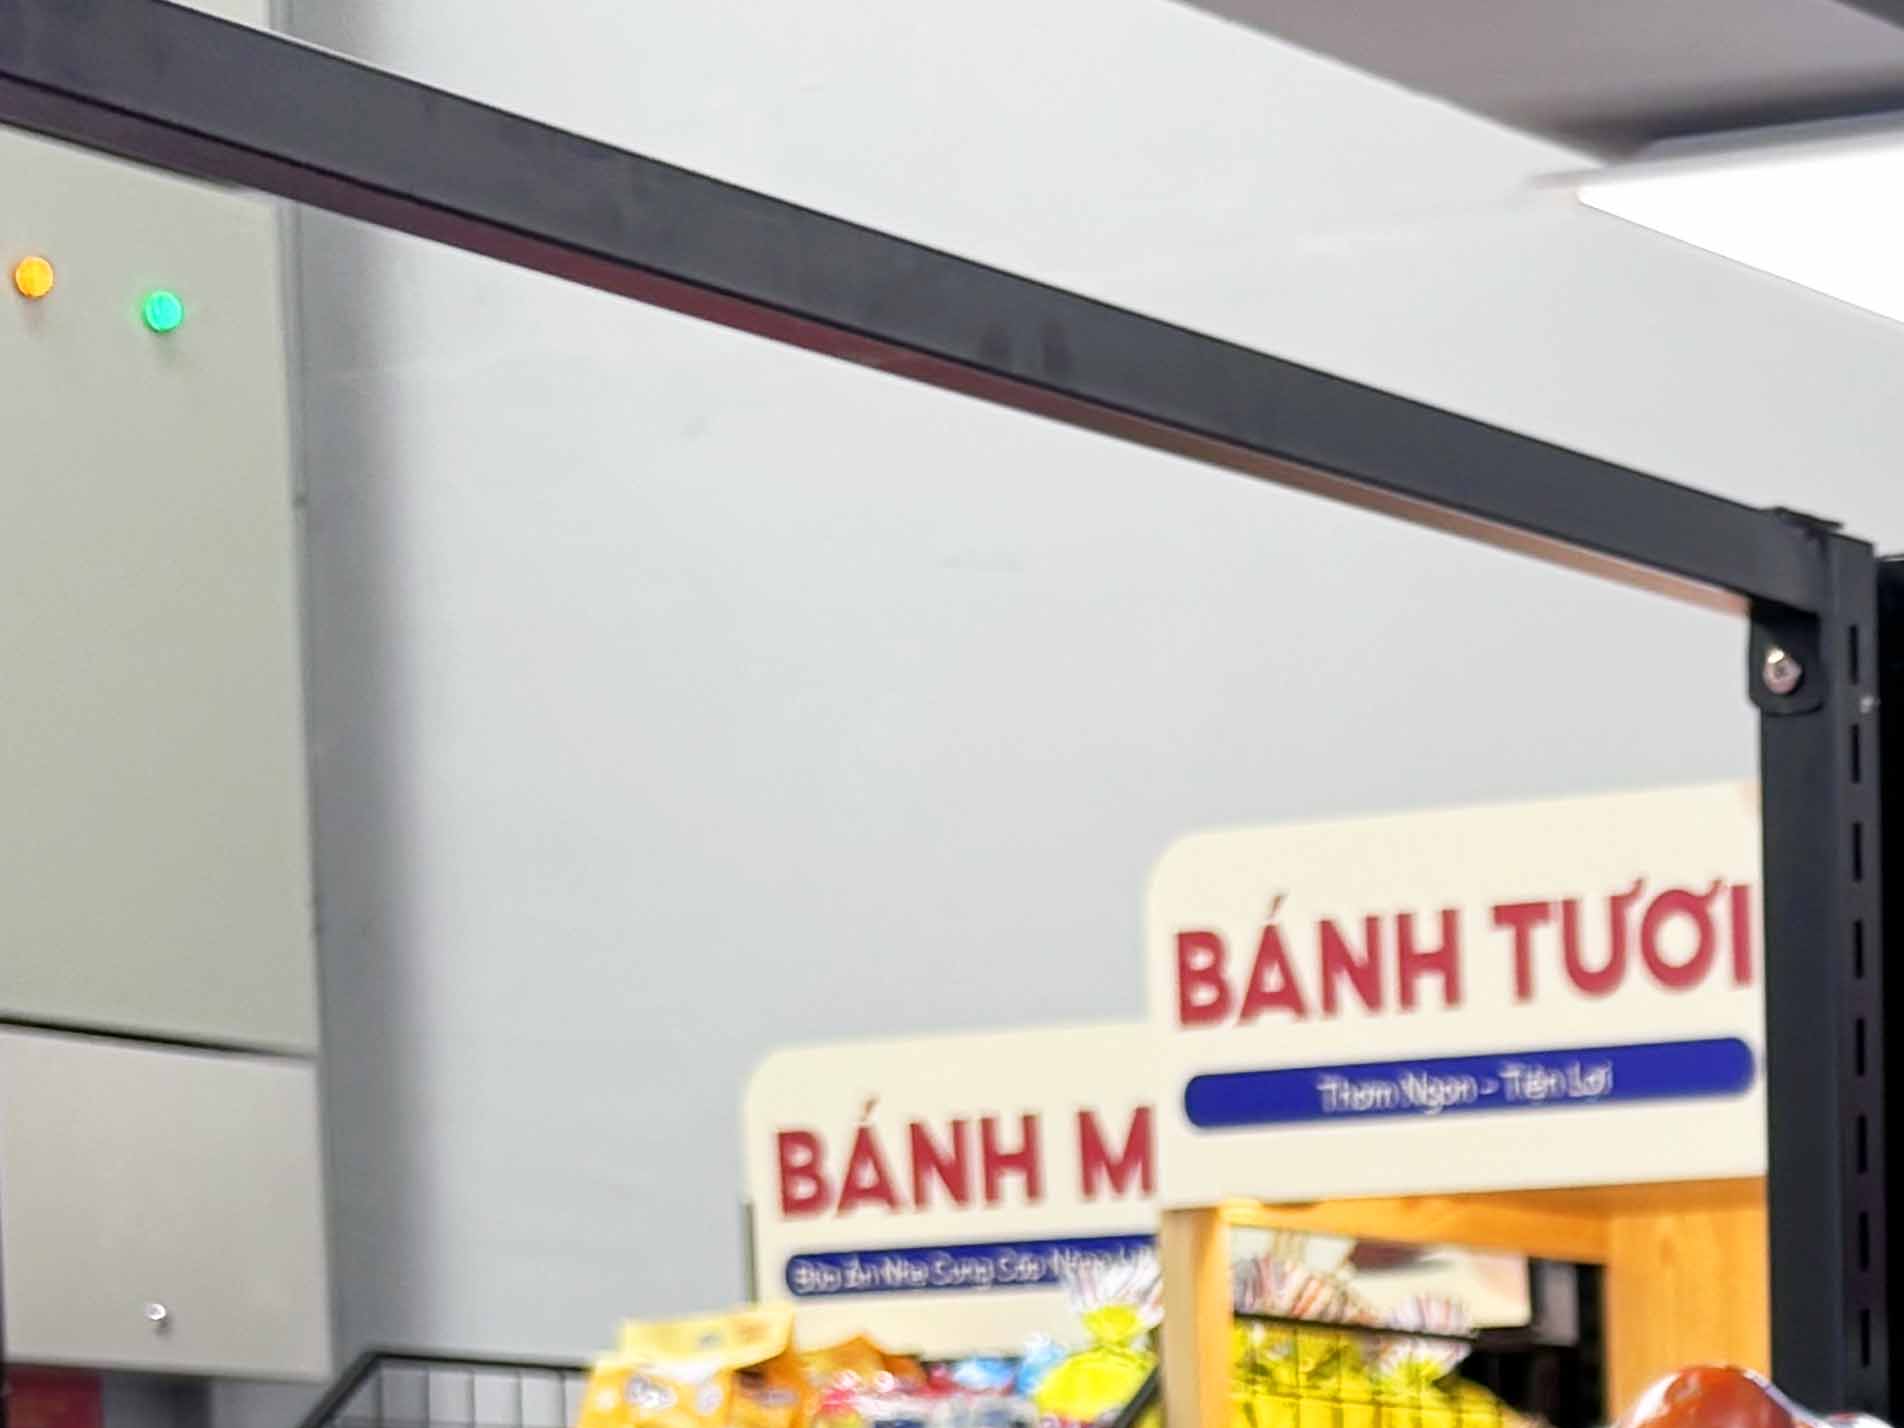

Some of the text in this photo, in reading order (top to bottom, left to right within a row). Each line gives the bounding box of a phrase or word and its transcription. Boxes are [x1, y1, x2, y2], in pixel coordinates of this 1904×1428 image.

[1174, 876, 1755, 1028] BÁNH TƯƠI
[773, 1089, 1159, 1220] BÁNH M
[1401, 1072, 1479, 1115] Ngon
